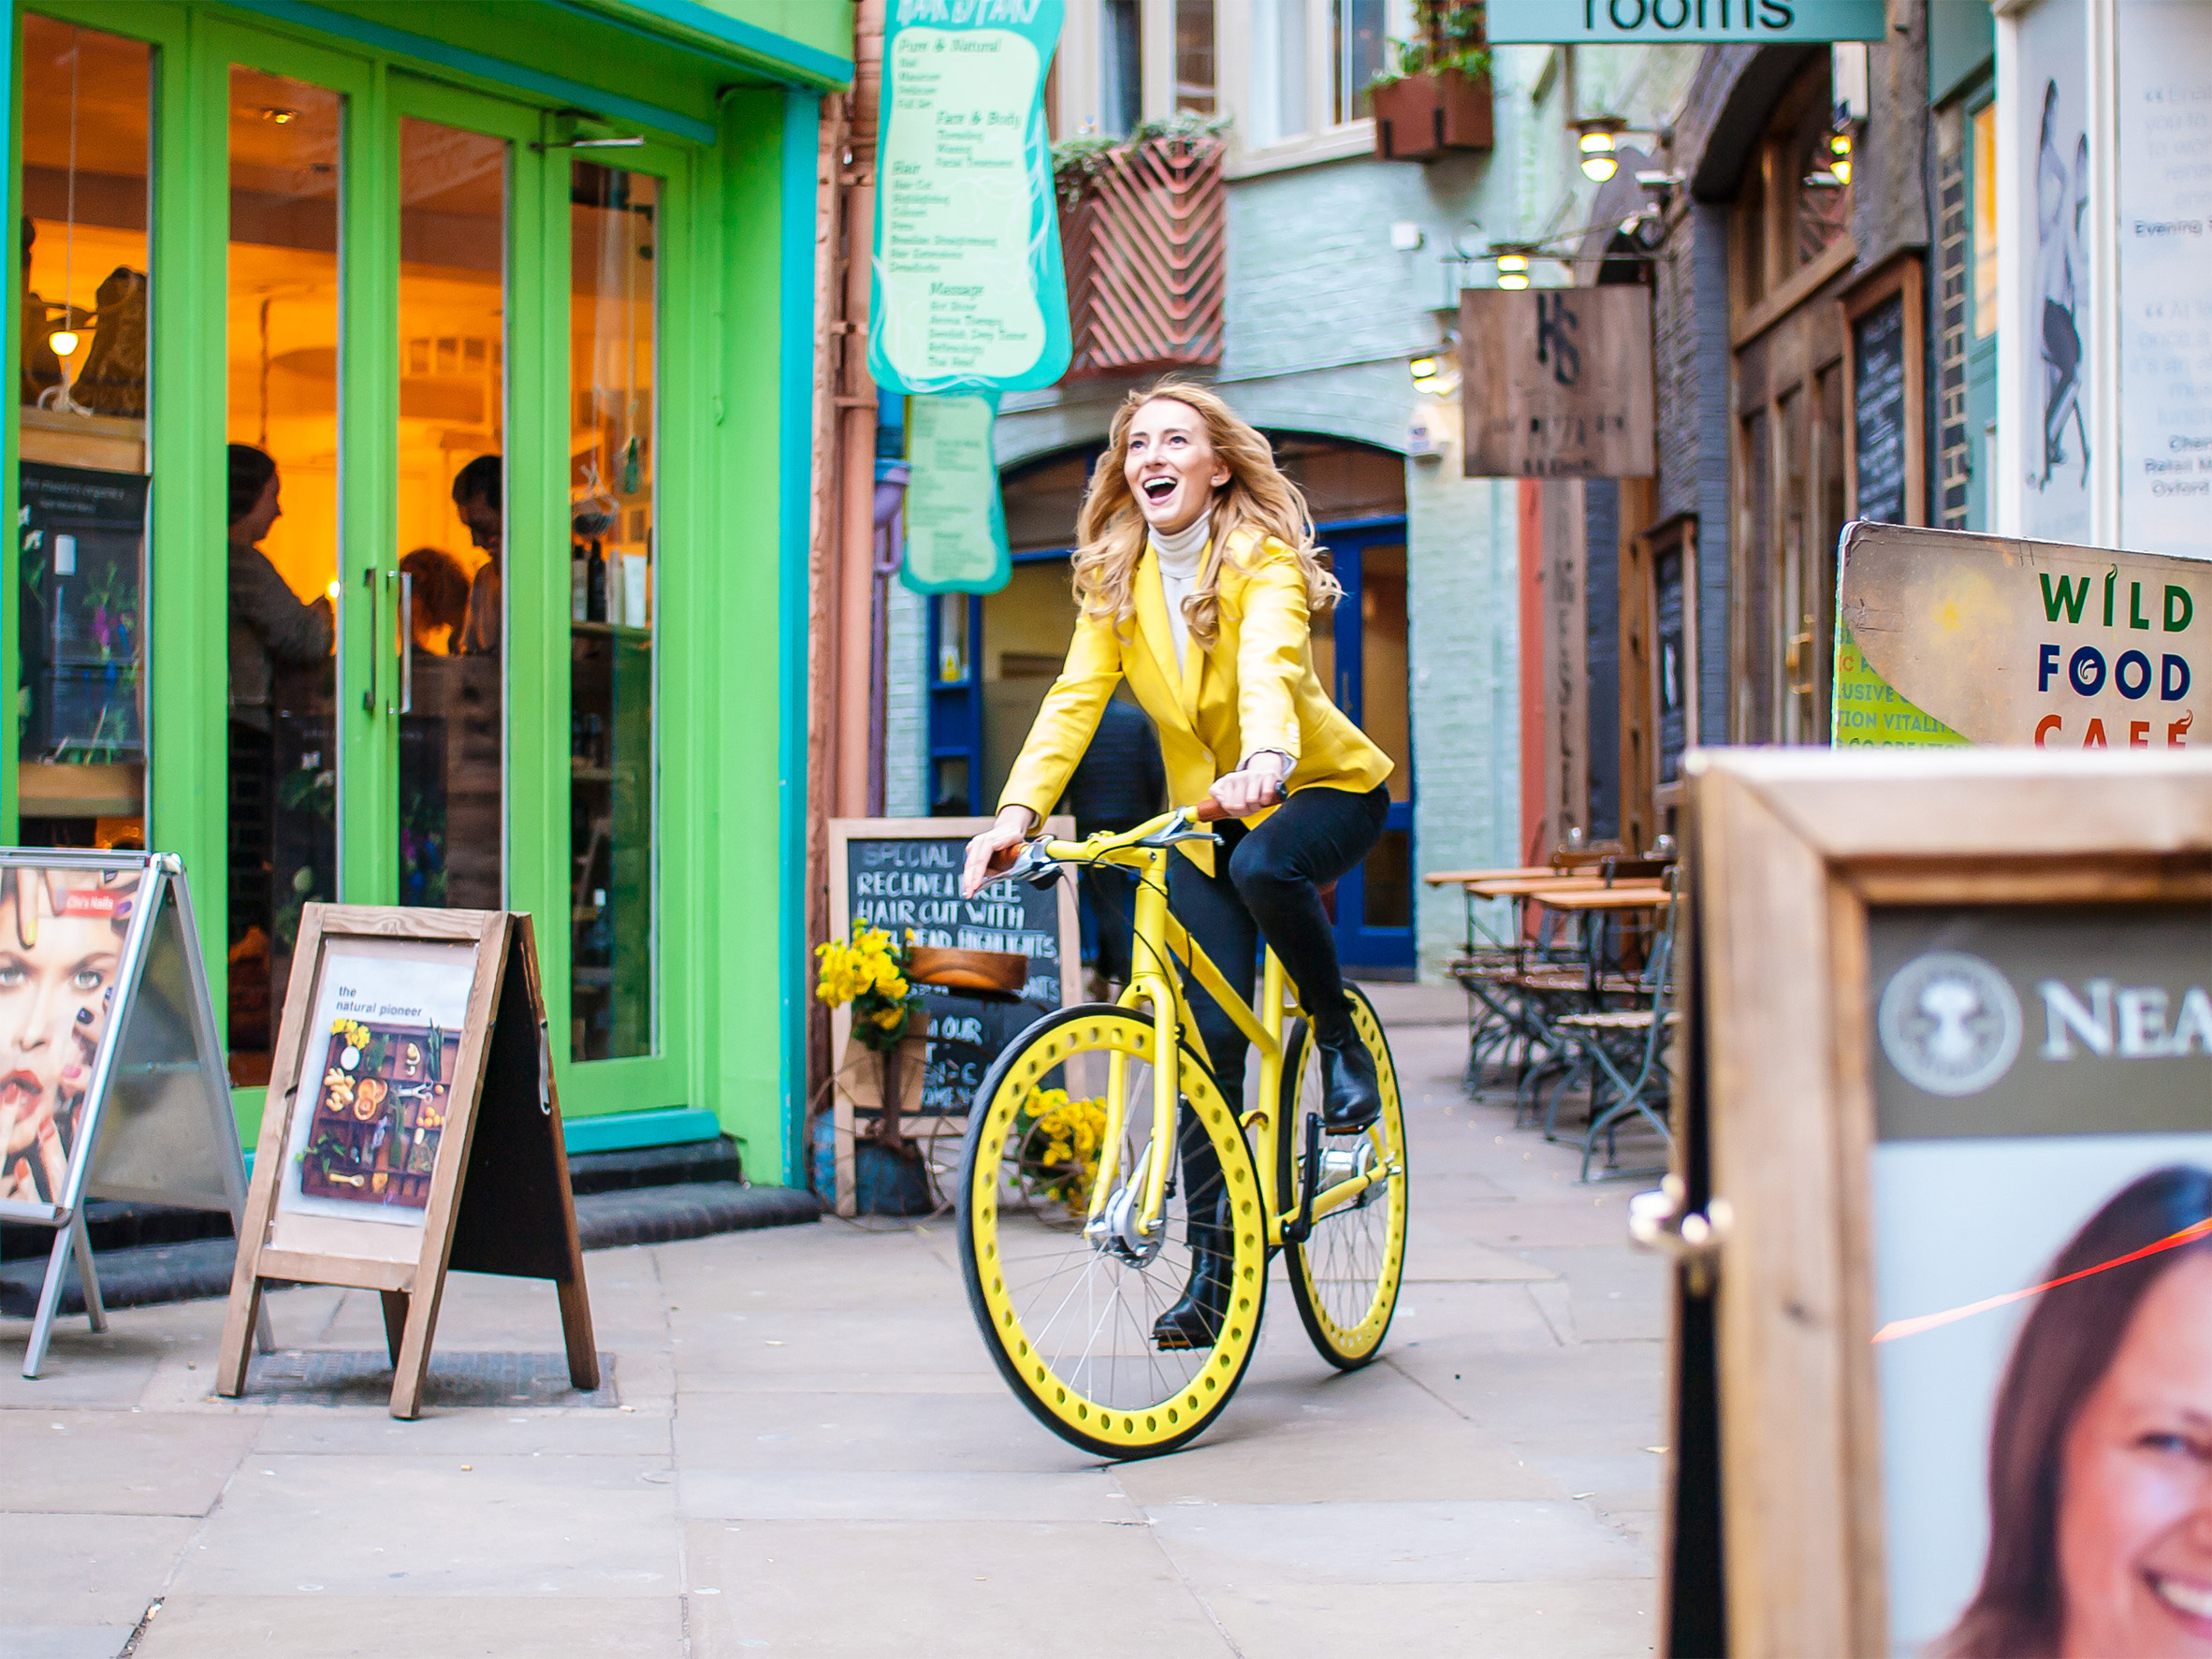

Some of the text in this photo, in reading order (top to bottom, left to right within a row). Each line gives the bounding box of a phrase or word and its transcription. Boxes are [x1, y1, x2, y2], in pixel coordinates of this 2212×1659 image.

[987, 111, 1021, 129] Body
[2039, 563, 2193, 633] WILD
[2038, 644, 2190, 701] FOOD
[857, 899, 915, 925] HAIR
[965, 901, 1025, 930] WITH
[339, 985, 357, 997] the
[336, 1001, 422, 1017] natural pioneer
